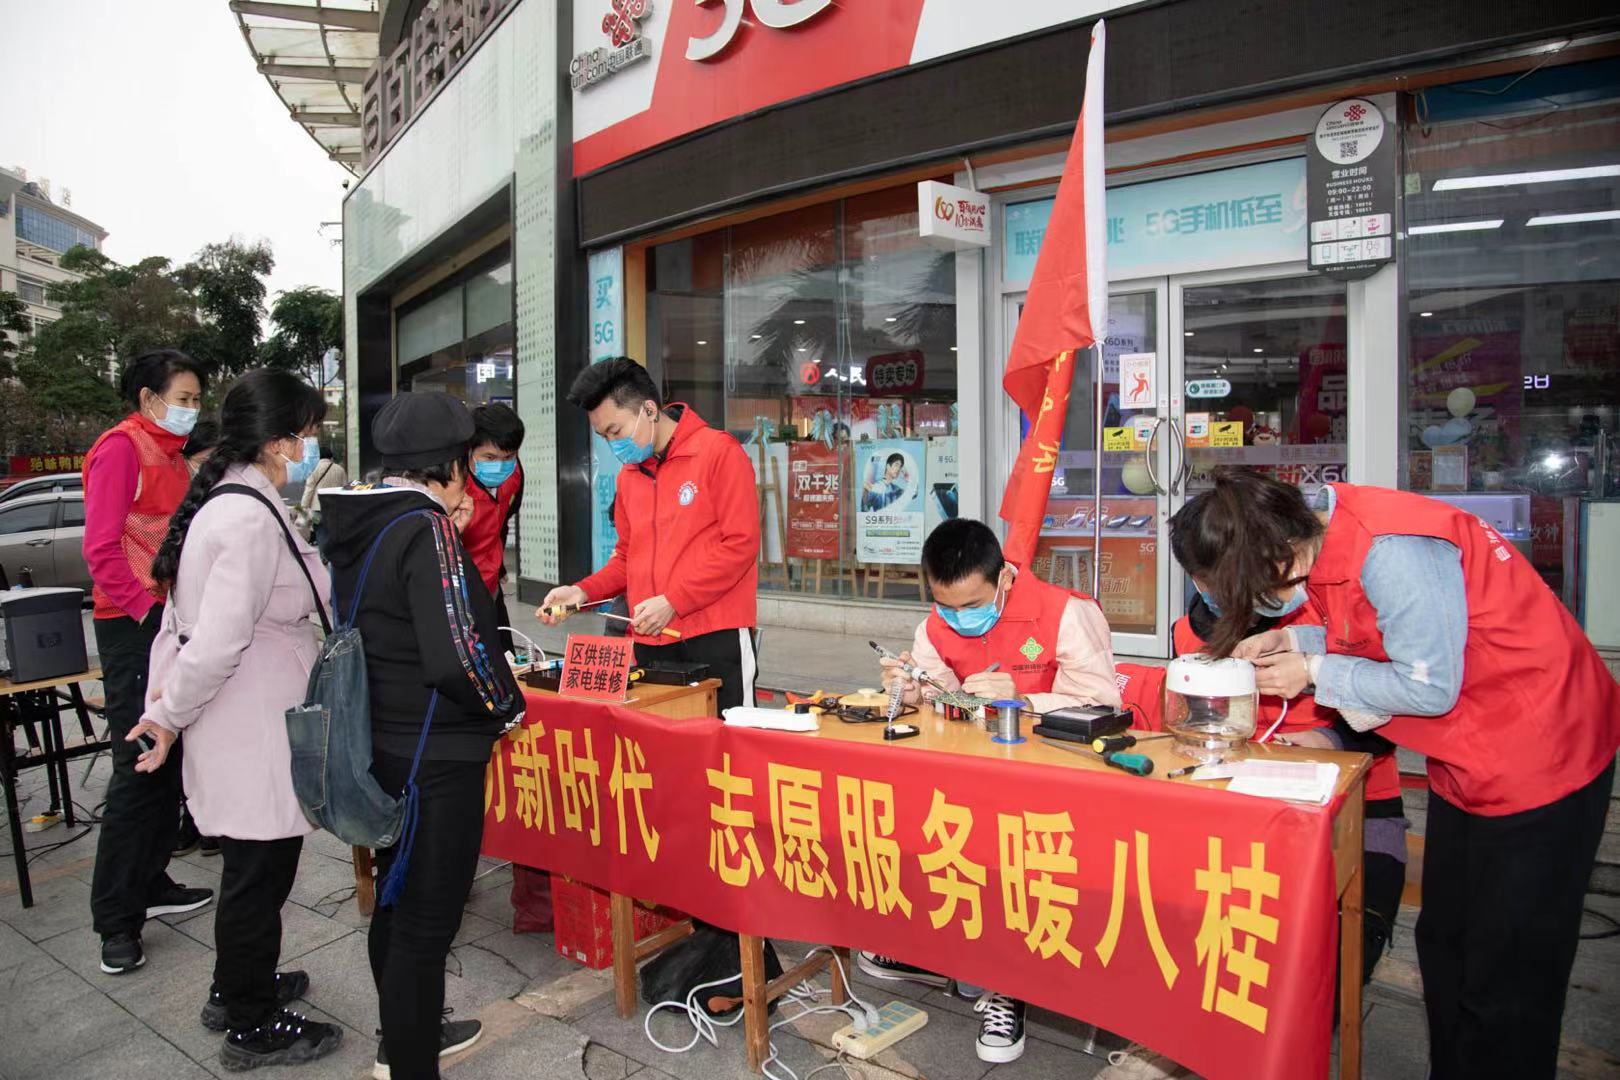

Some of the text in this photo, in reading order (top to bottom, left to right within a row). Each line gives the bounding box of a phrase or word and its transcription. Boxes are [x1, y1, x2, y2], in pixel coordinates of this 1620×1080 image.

[1146, 194, 1282, 234] 5G手机低至
[798, 472, 839, 491] 双千兆
[1301, 466, 1347, 484] X6
[570, 642, 626, 668] 区供销社
[566, 667, 623, 693] 家电维修
[706, 752, 1281, 1034] 志愿服务暖八桂
